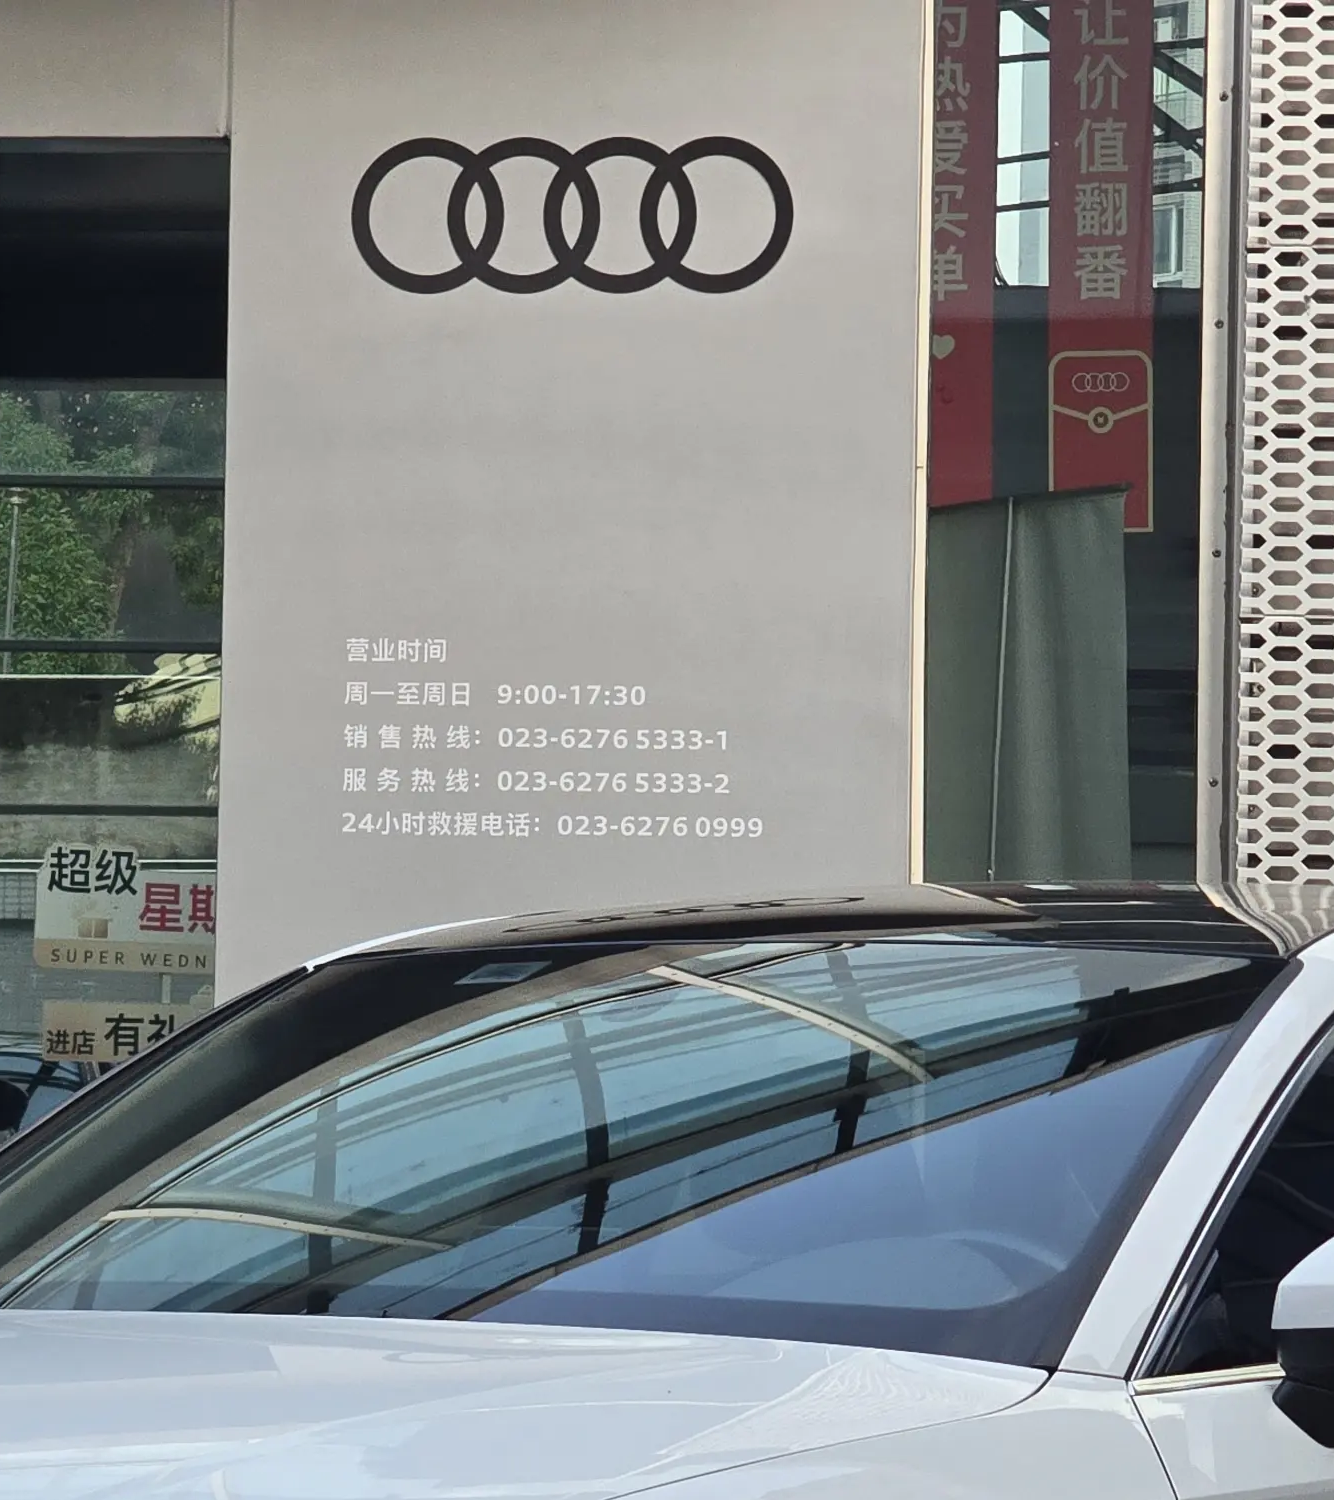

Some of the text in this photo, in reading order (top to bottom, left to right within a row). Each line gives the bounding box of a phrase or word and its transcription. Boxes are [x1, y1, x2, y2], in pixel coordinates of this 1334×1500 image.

[1073, 0, 1129, 301] 让价值翻番
[346, 637, 447, 663] 营业时间
[344, 681, 646, 707] 周一至周日 9:00-17:30
[498, 727, 628, 749] 023-6276
[635, 729, 728, 751] 5333-1
[497, 770, 627, 793] 023-6276
[634, 772, 730, 794] 5333-2
[557, 815, 688, 837] 023-6276
[695, 816, 763, 838] 0999
[48, 846, 138, 896] 超级
[50, 948, 206, 969] SUPER WEDN
